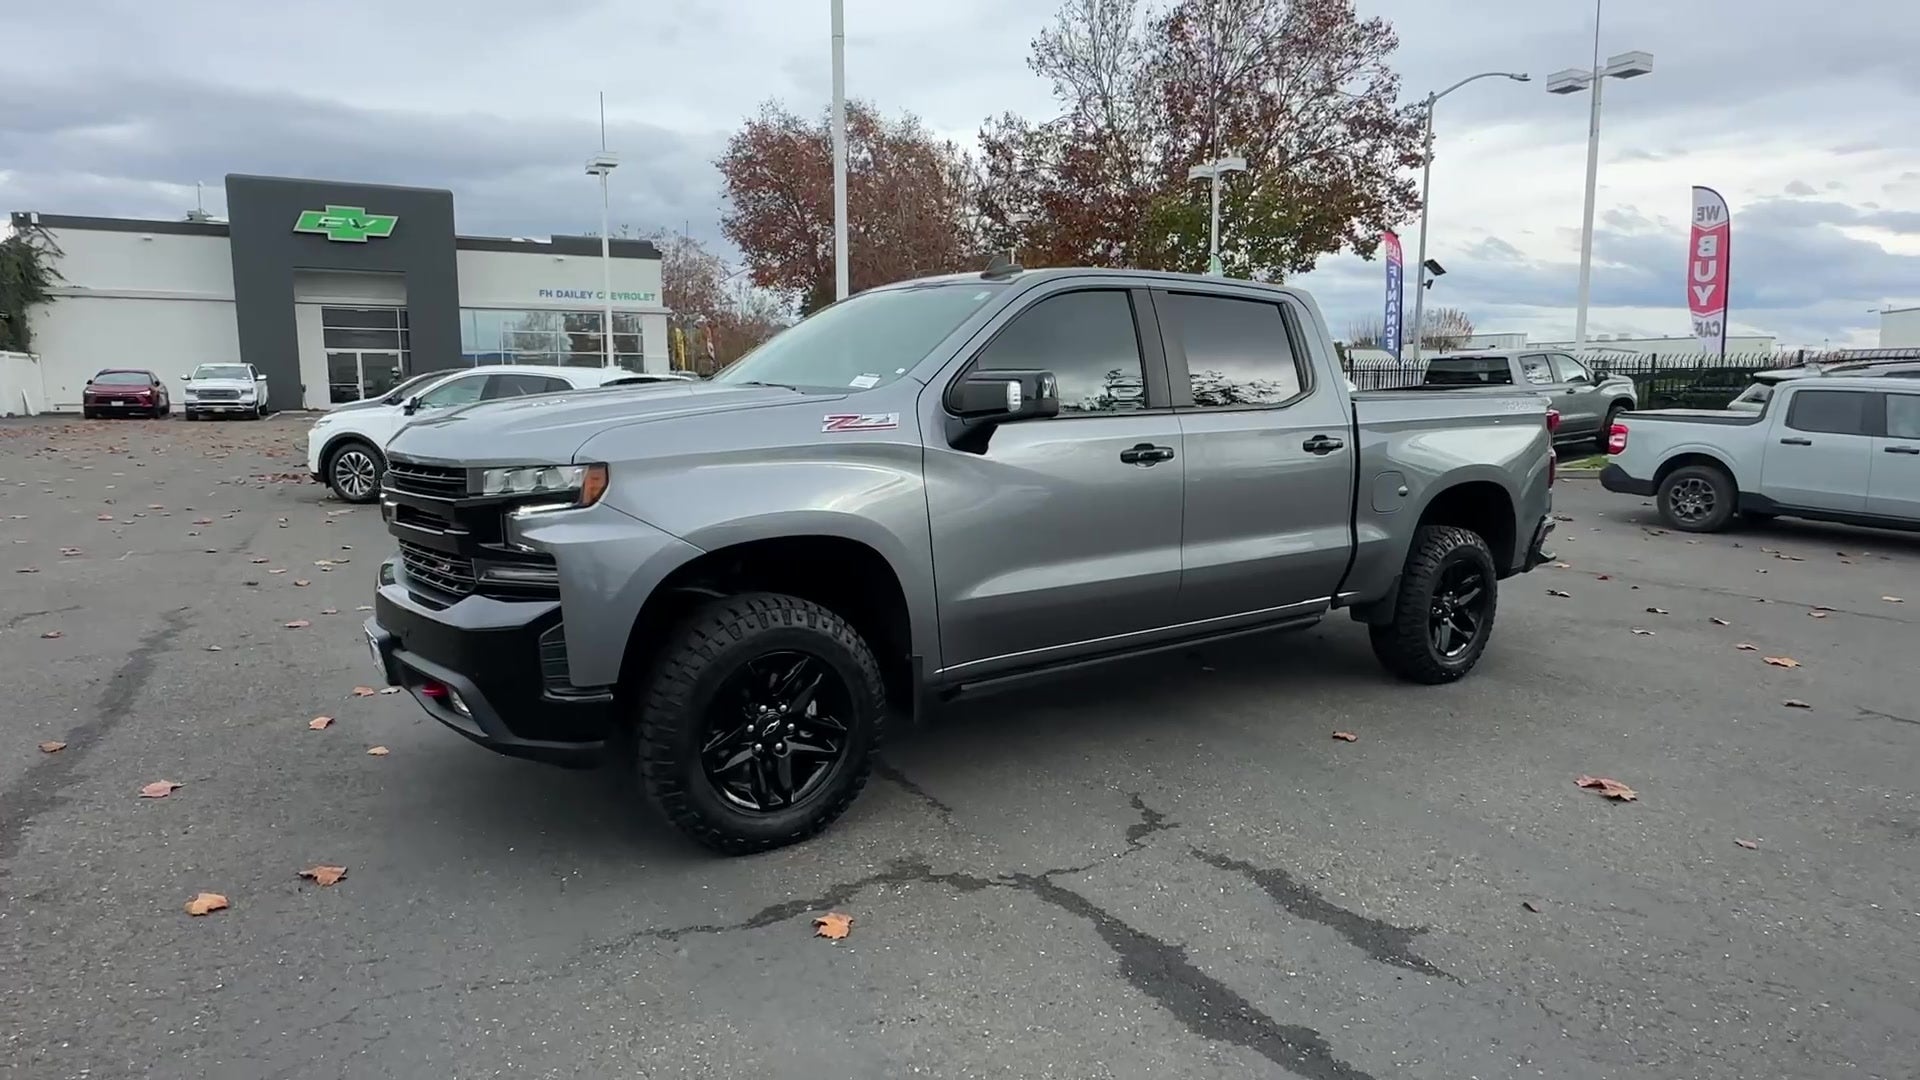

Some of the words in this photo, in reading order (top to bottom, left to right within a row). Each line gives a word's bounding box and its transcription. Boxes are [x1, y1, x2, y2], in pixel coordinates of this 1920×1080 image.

[539, 289, 553, 298] FH
[556, 290, 594, 299] DAILEY
[596, 291, 656, 301] CEVROLET
